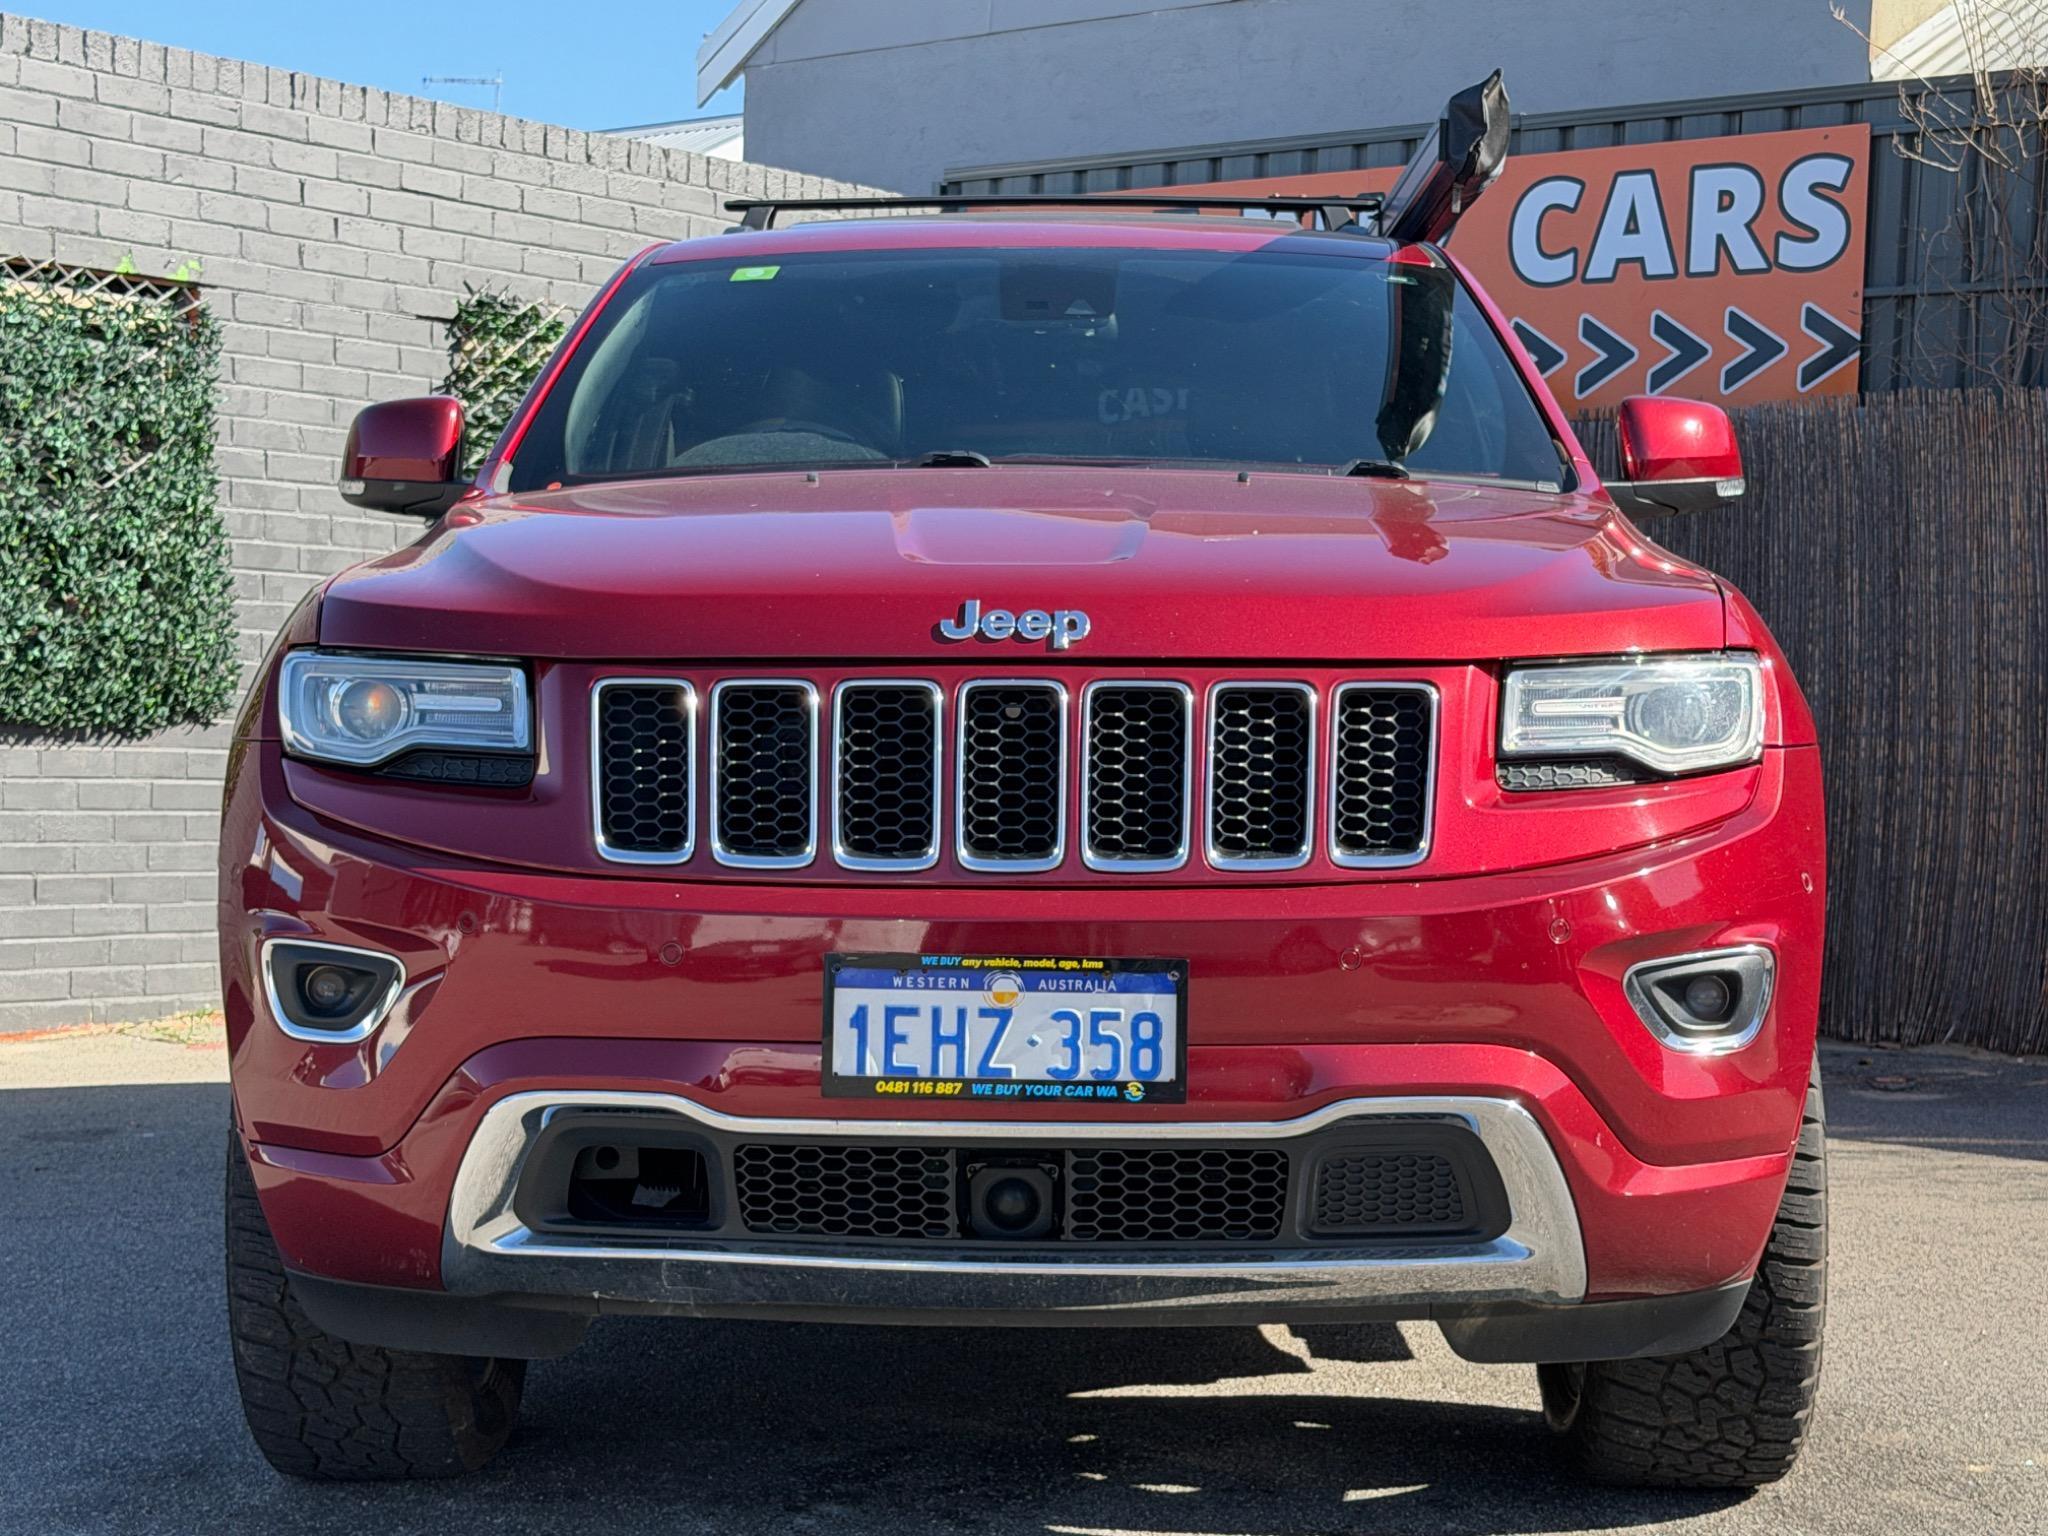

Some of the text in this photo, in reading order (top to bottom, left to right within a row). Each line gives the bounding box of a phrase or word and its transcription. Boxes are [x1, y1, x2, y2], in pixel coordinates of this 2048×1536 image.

[1508, 152, 1855, 288] CARS
[940, 599, 1091, 649] Jeep
[920, 955, 1104, 971] WE BUY any vehicle, model, age, kms
[893, 975, 1118, 992] WESTERN AUSTRALIA
[875, 1080, 1118, 1098] 0481 116 887 WE BUY YOUR CAR WA
